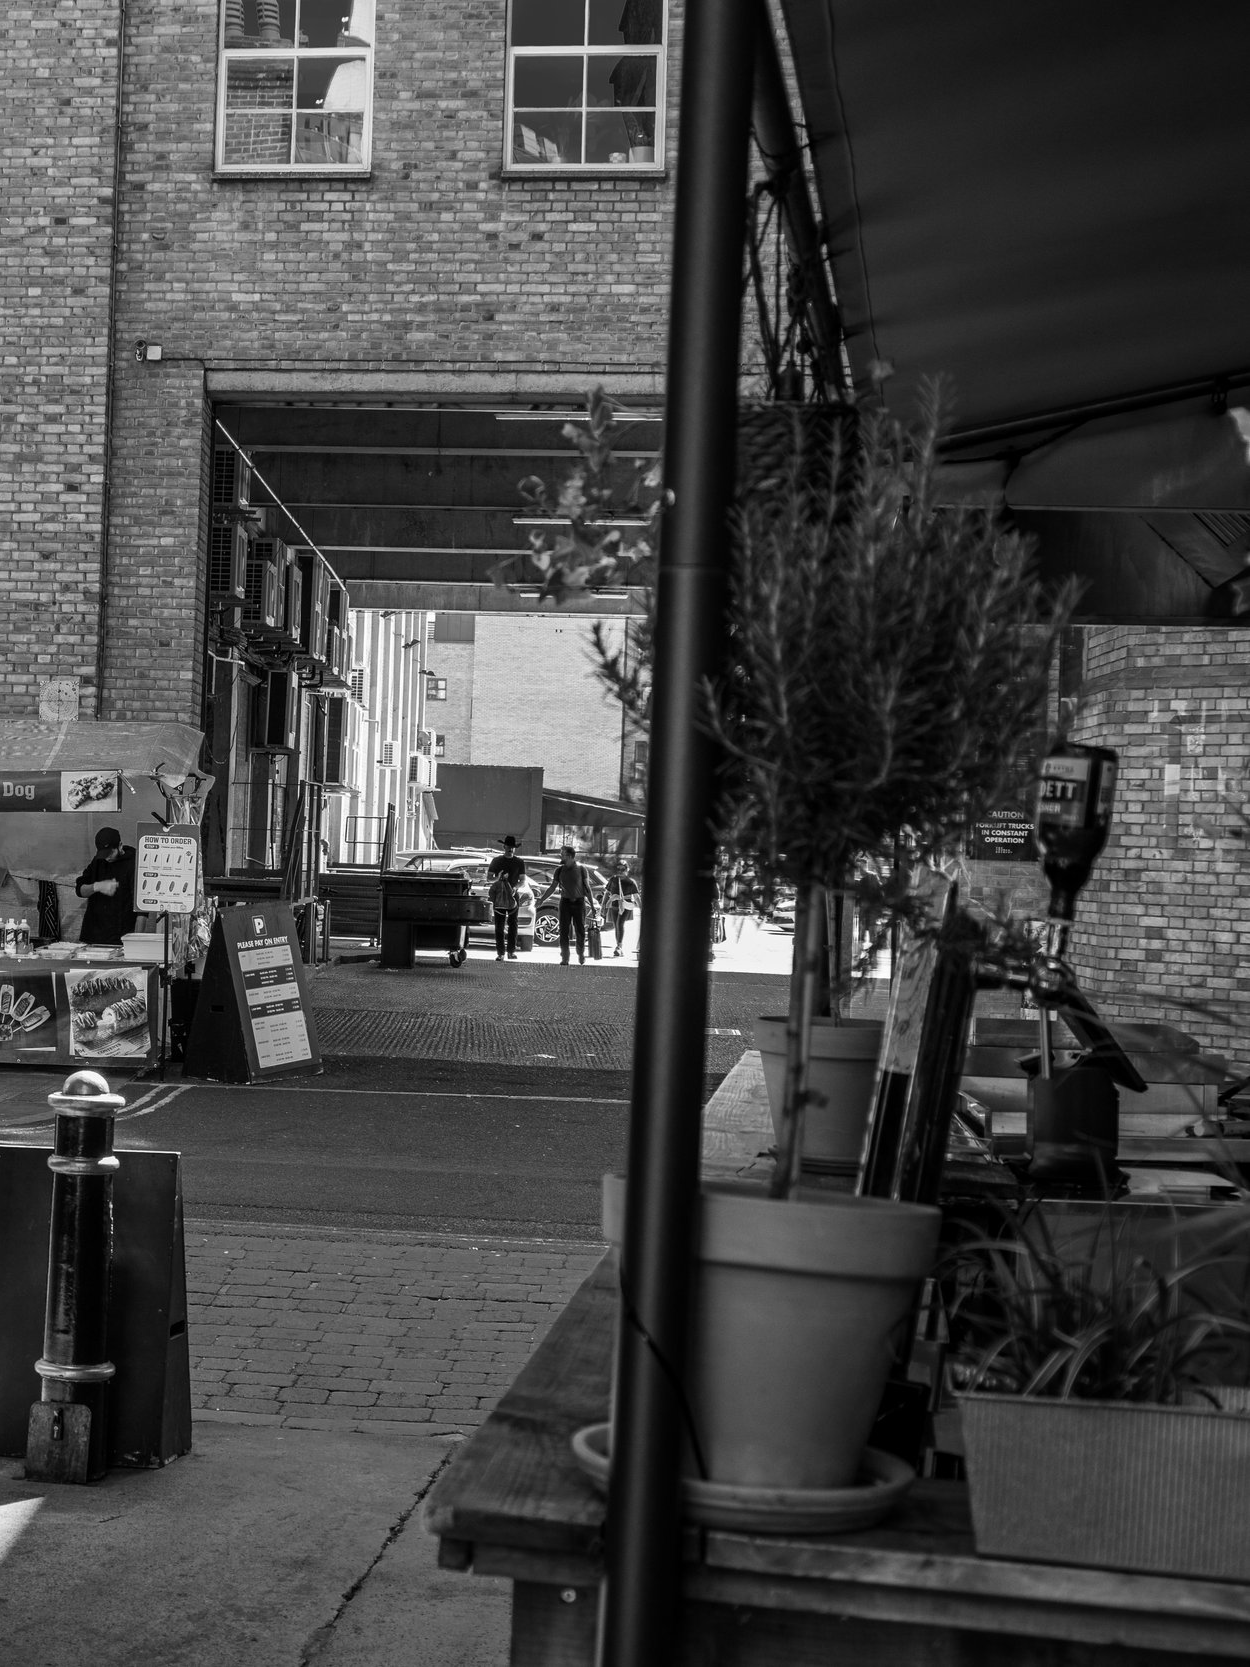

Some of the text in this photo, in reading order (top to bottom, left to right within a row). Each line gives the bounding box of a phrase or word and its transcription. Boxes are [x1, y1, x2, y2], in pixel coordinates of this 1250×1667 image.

[2, 781, 36, 800] Dog
[984, 836, 1024, 844] OPERATION
[254, 918, 264, 934] P
[237, 935, 288, 950] PLEASE PAY ON ENTRY
